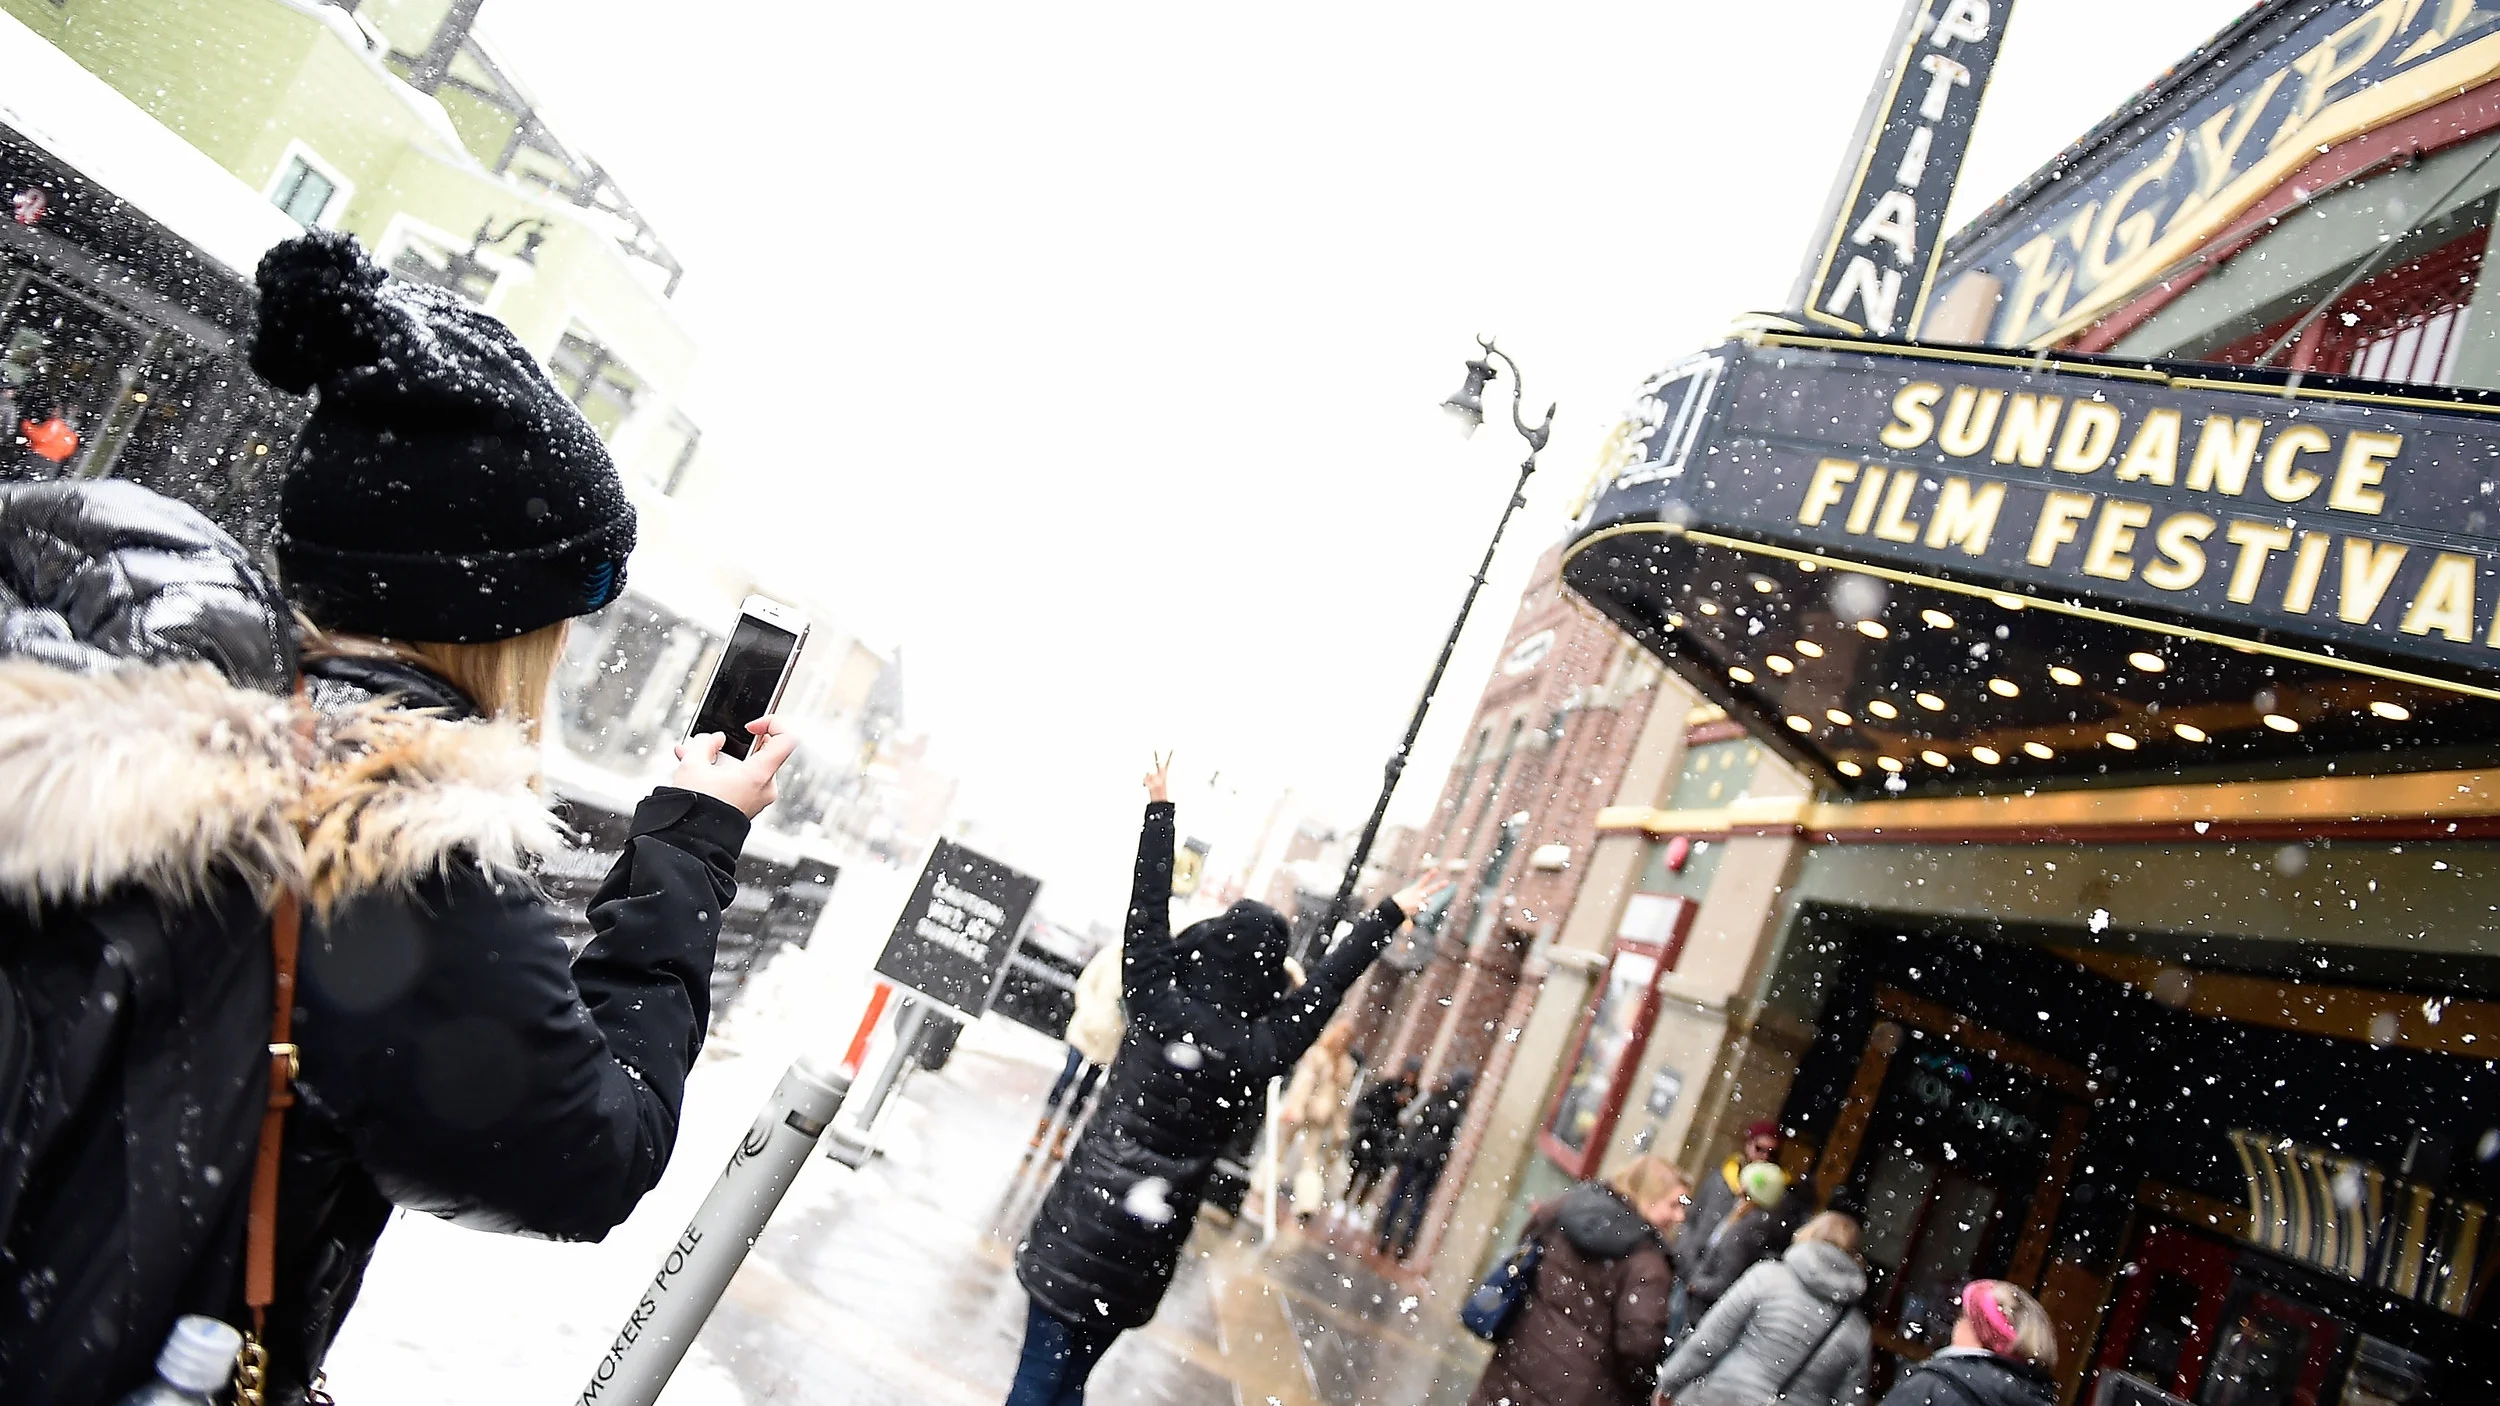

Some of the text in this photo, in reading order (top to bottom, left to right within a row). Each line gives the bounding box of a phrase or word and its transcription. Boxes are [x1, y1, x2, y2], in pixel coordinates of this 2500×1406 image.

[1826, 0, 1991, 336] PTIAN
[1881, 382, 2403, 514] SUNDANCE
[1797, 457, 2007, 556] FILM
[656, 1226, 703, 1292] POLE
